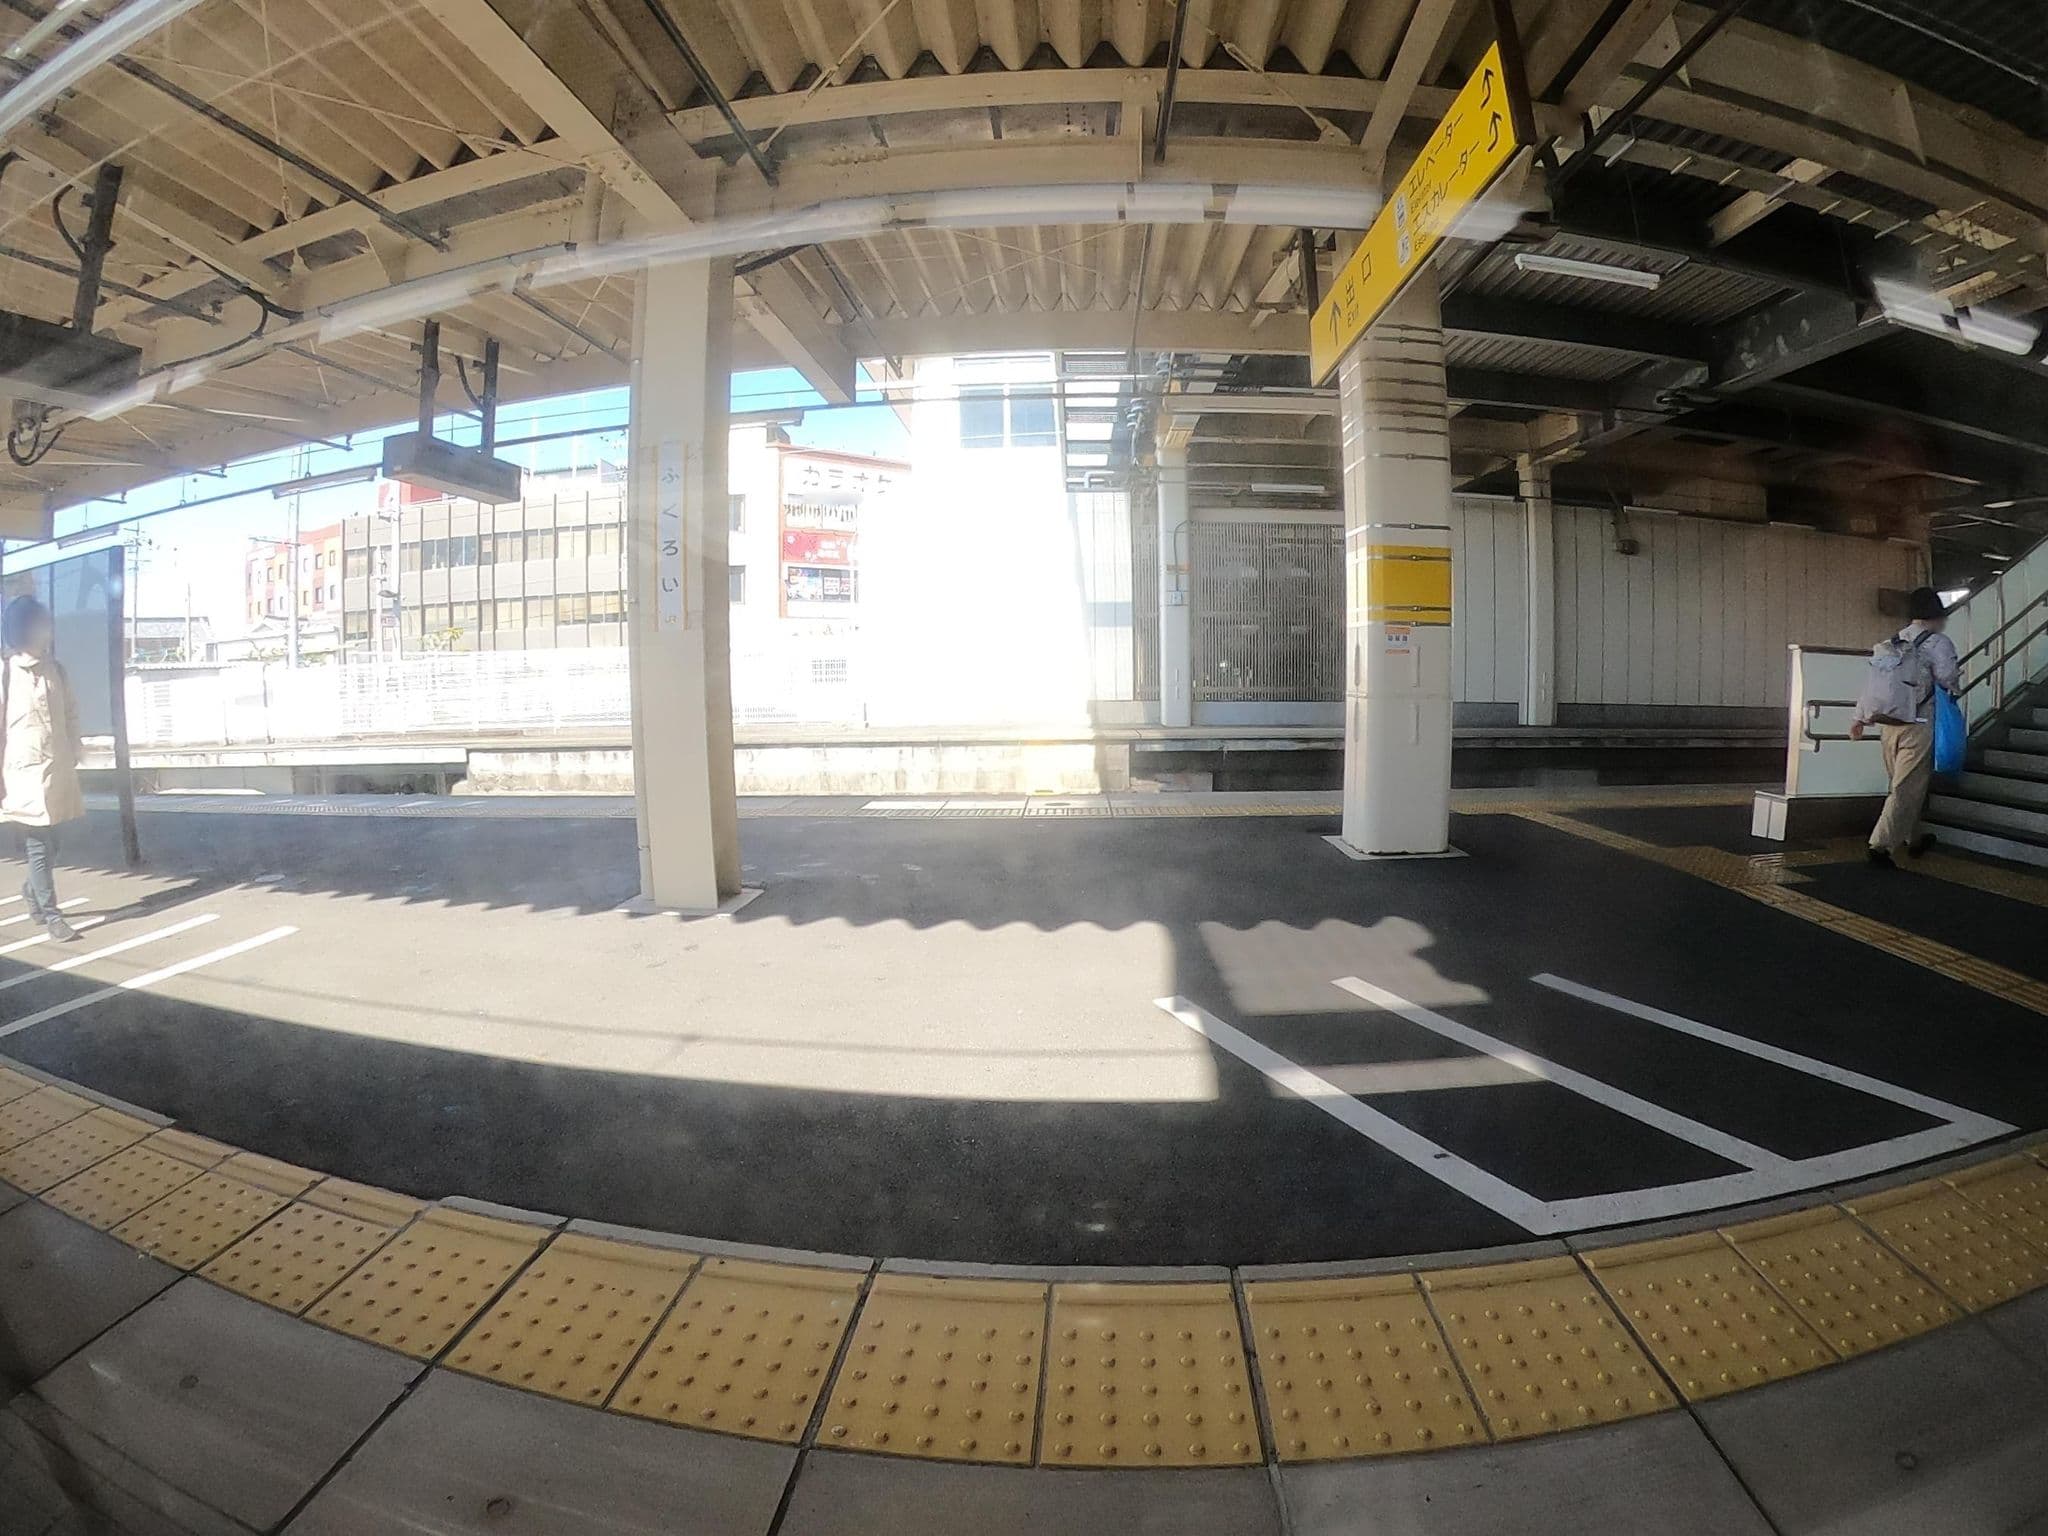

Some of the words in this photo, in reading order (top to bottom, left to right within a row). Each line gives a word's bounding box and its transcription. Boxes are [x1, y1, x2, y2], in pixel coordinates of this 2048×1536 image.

[1412, 141, 1480, 237] エスカレーター
[1345, 252, 1374, 306] 出口
[661, 467, 680, 593] ふくろい
